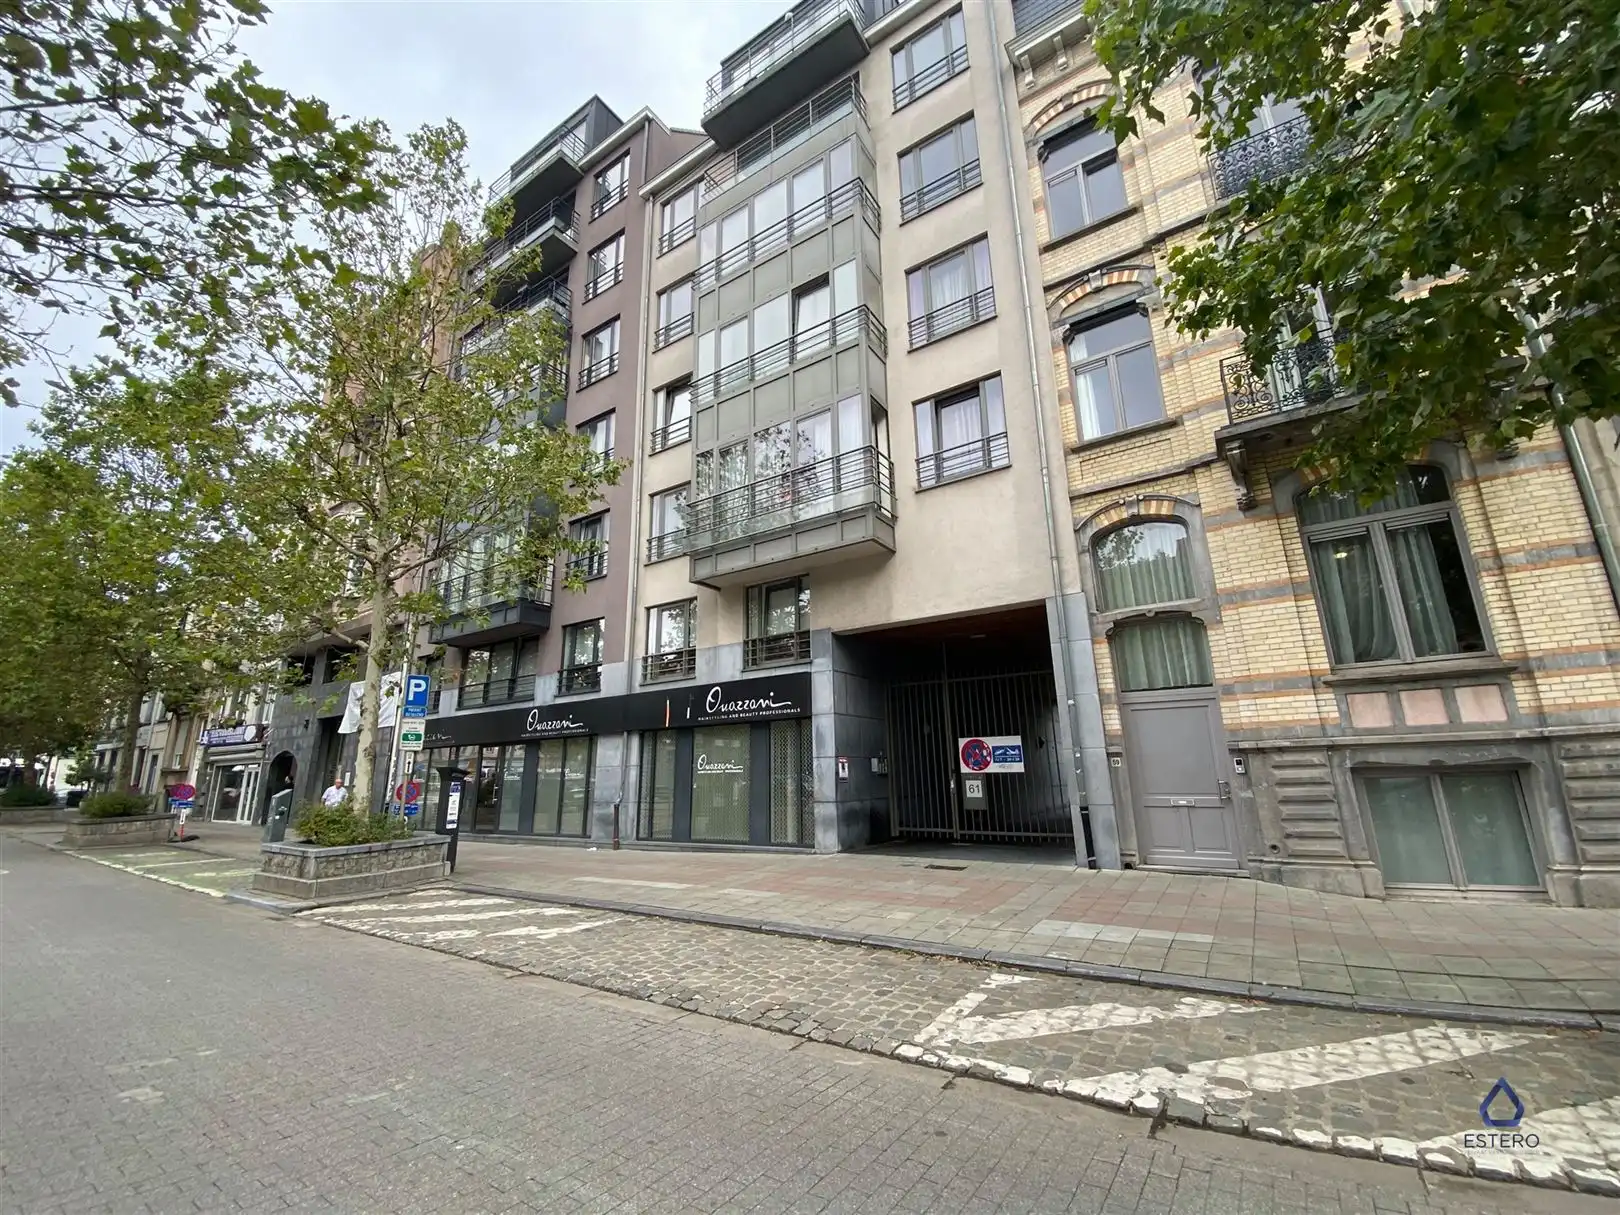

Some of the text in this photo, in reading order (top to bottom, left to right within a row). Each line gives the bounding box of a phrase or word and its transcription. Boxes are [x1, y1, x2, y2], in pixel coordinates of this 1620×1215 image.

[408, 679, 427, 701] P
[706, 686, 792, 713] Ouazzani
[527, 709, 583, 731] Ouazzani
[969, 784, 980, 794] 61
